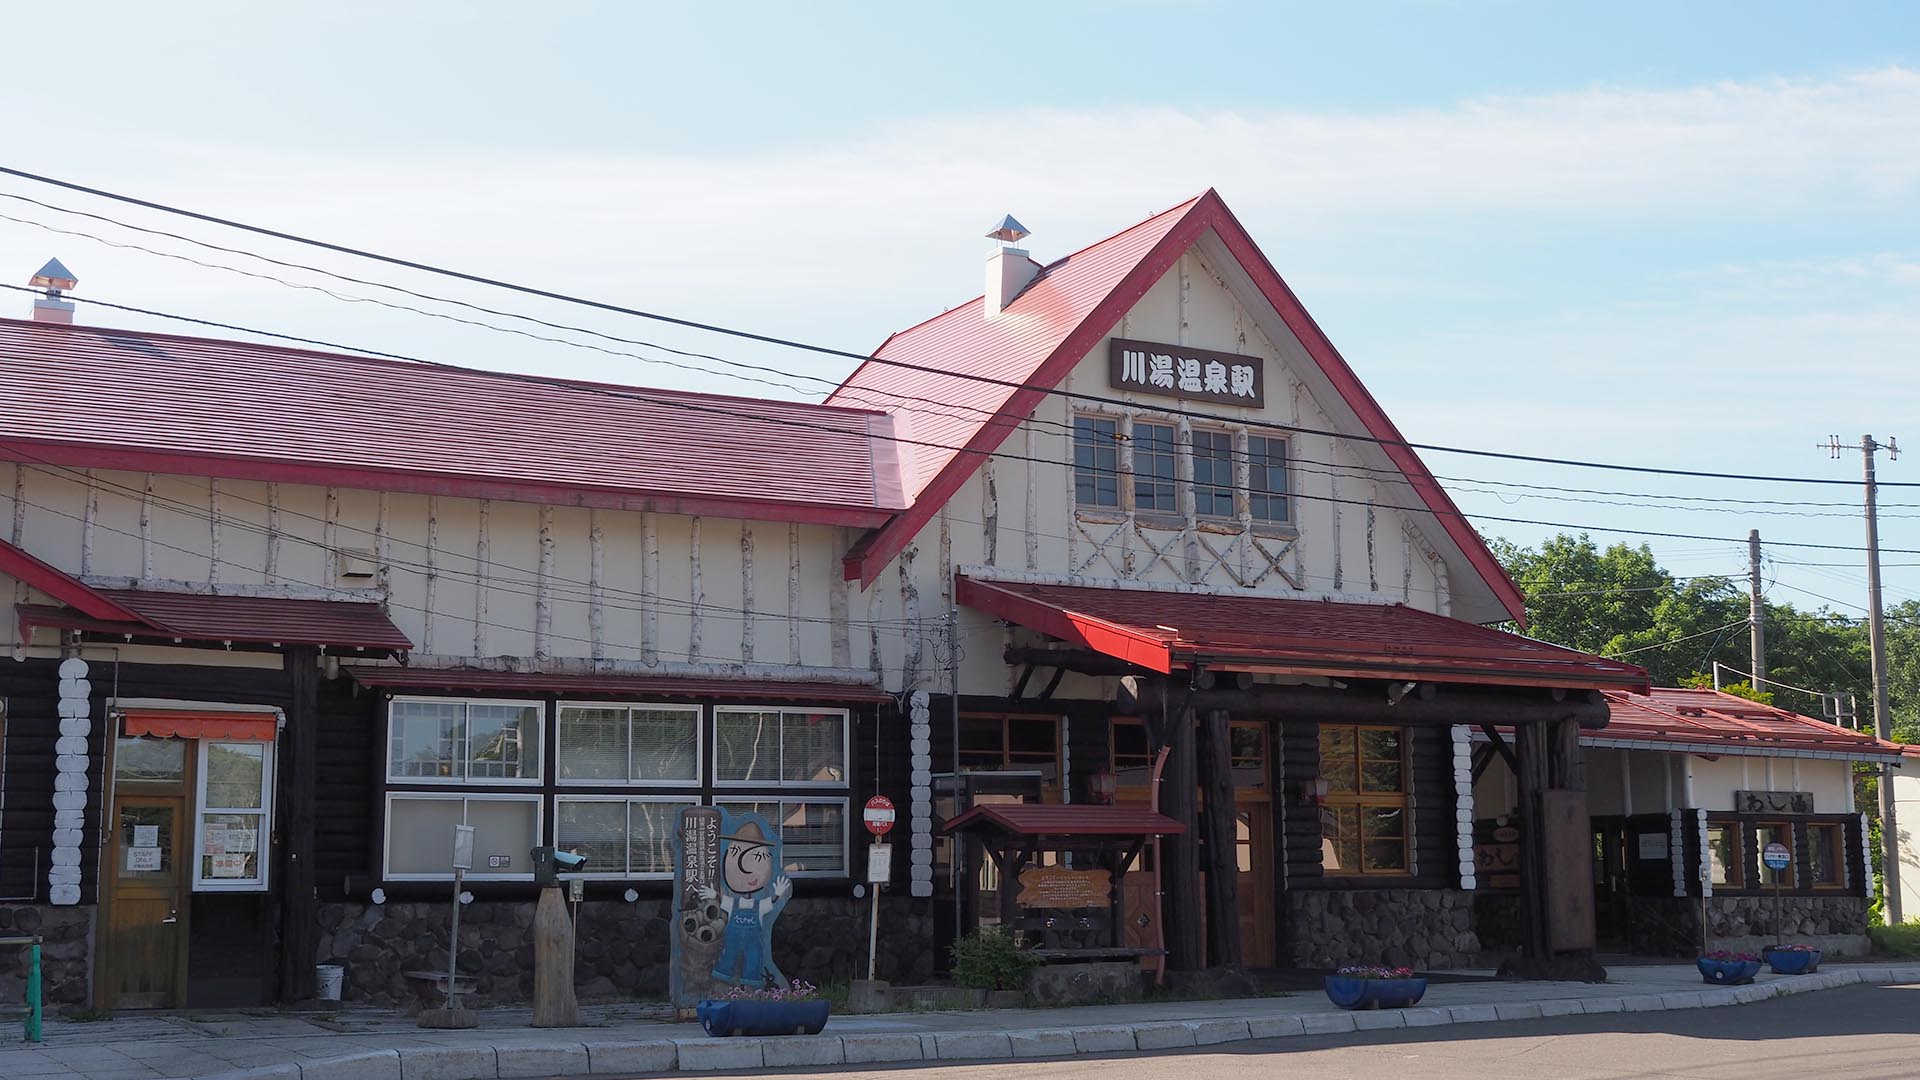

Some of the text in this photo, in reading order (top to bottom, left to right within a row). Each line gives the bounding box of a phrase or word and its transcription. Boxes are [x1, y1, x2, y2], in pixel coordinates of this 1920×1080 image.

[1121, 350, 1255, 398] 川湯温泉駅
[684, 816, 699, 893] 川湯温泉駅へ
